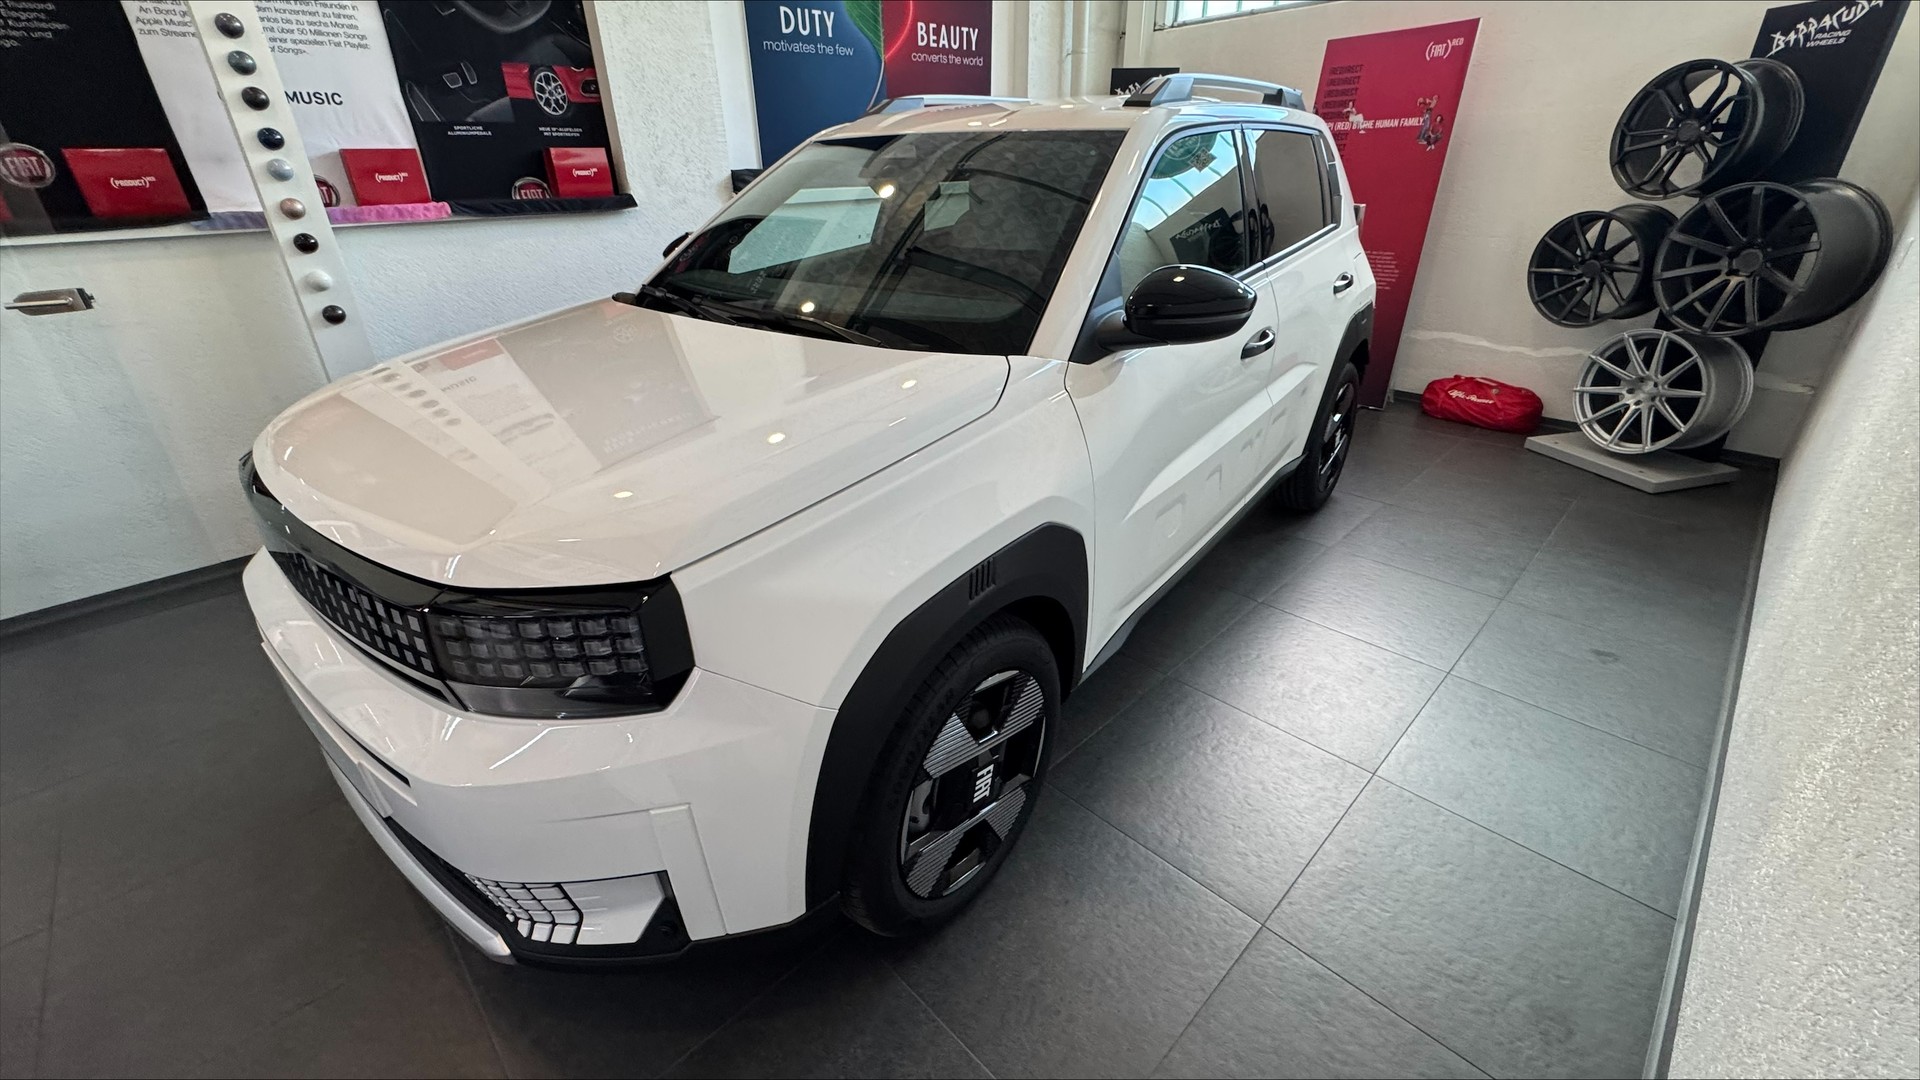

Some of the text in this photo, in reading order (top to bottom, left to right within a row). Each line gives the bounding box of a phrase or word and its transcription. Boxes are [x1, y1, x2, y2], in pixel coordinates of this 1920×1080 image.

[139, 5, 152, 14] An
[153, 6, 177, 16] Bord
[136, 16, 193, 27] Apple Music
[330, 21, 359, 30] Monate
[779, 6, 835, 38] DUTY
[277, 26, 295, 34] über
[309, 29, 342, 38] Millionen
[343, 31, 367, 41] Songs
[917, 22, 979, 51] BEAUTY
[1814, 29, 1852, 40] RACING
[763, 39, 854, 56] motivates the few
[1806, 37, 1846, 48] WHEELS
[911, 52, 984, 67] converts the world
[284, 90, 343, 106] MUSIC
[1375, 118, 1400, 129] HUMAN
[4, 155, 43, 178] FIAT
[973, 763, 995, 803] FIAT
